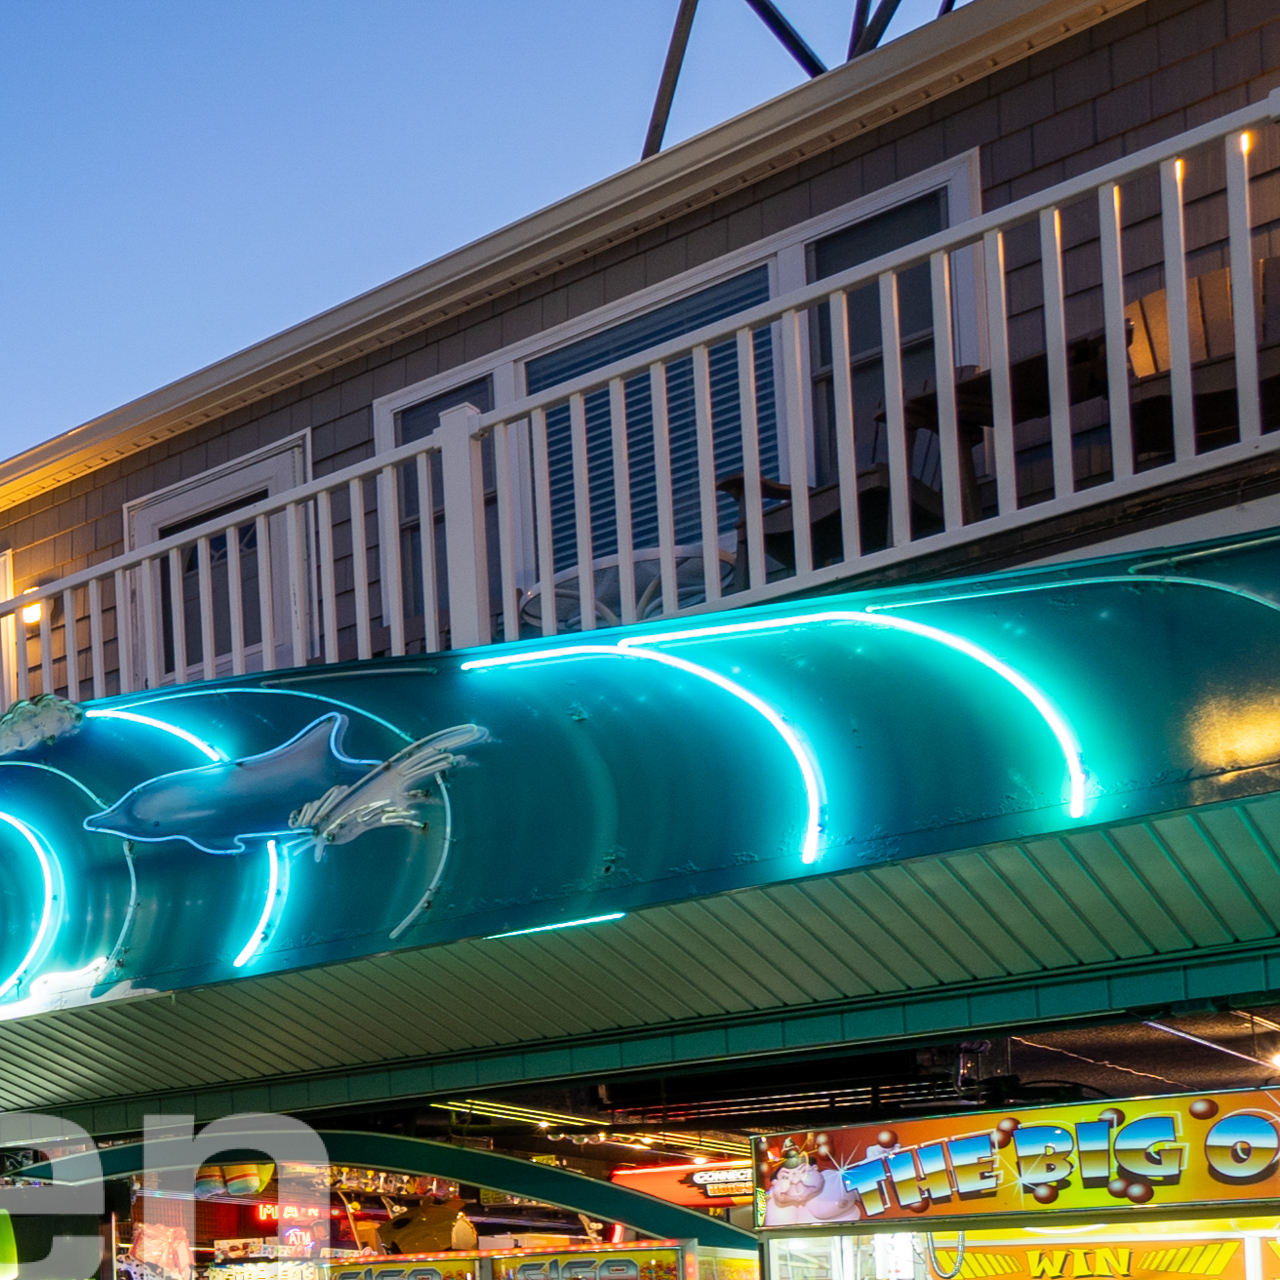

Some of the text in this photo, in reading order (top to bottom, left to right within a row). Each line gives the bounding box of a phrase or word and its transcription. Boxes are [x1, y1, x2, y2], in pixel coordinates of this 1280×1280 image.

[842, 1132, 1001, 1216] THE
[1013, 1113, 1185, 1187] BIG
[289, 1231, 311, 1246] ATM
[1024, 1247, 1133, 1279] WIN
